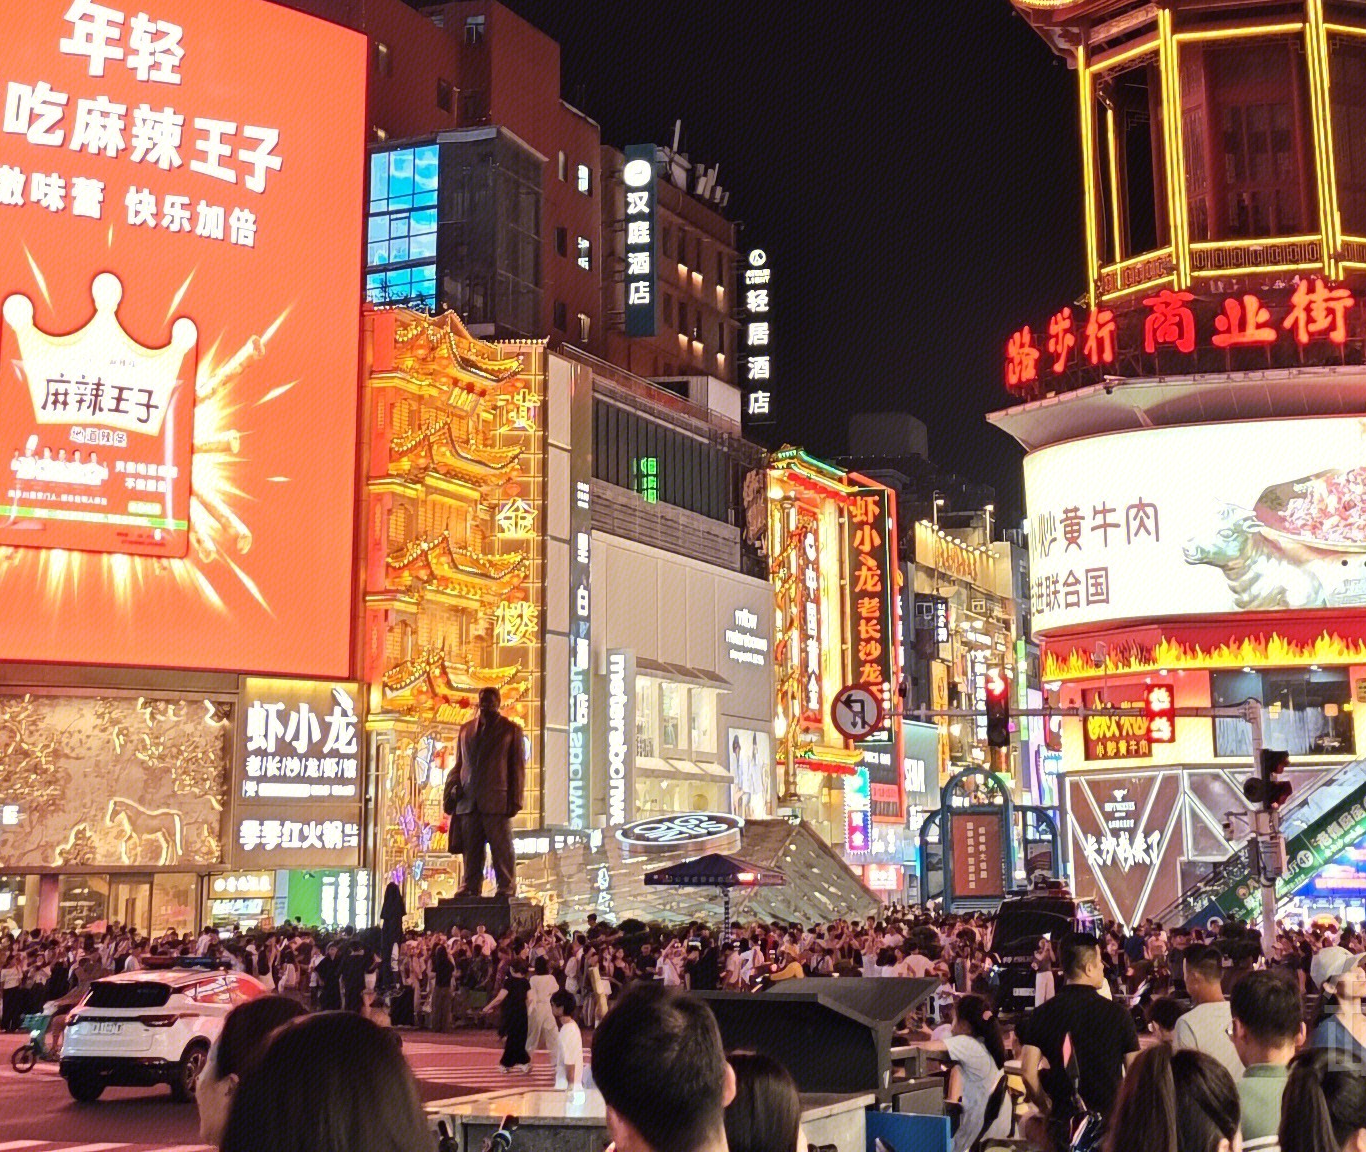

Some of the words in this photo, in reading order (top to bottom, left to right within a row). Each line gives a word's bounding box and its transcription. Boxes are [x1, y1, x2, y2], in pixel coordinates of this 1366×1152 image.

[124, 185, 258, 249] 快乐加倍
[627, 192, 651, 305] 汉庭酒店
[746, 289, 771, 415] 轻居酒店
[41, 373, 159, 424] 麻辣王子
[857, 597, 884, 698] 老长沙龙
[246, 686, 359, 754] 虾小龙
[239, 819, 344, 851] 季季红火锅
